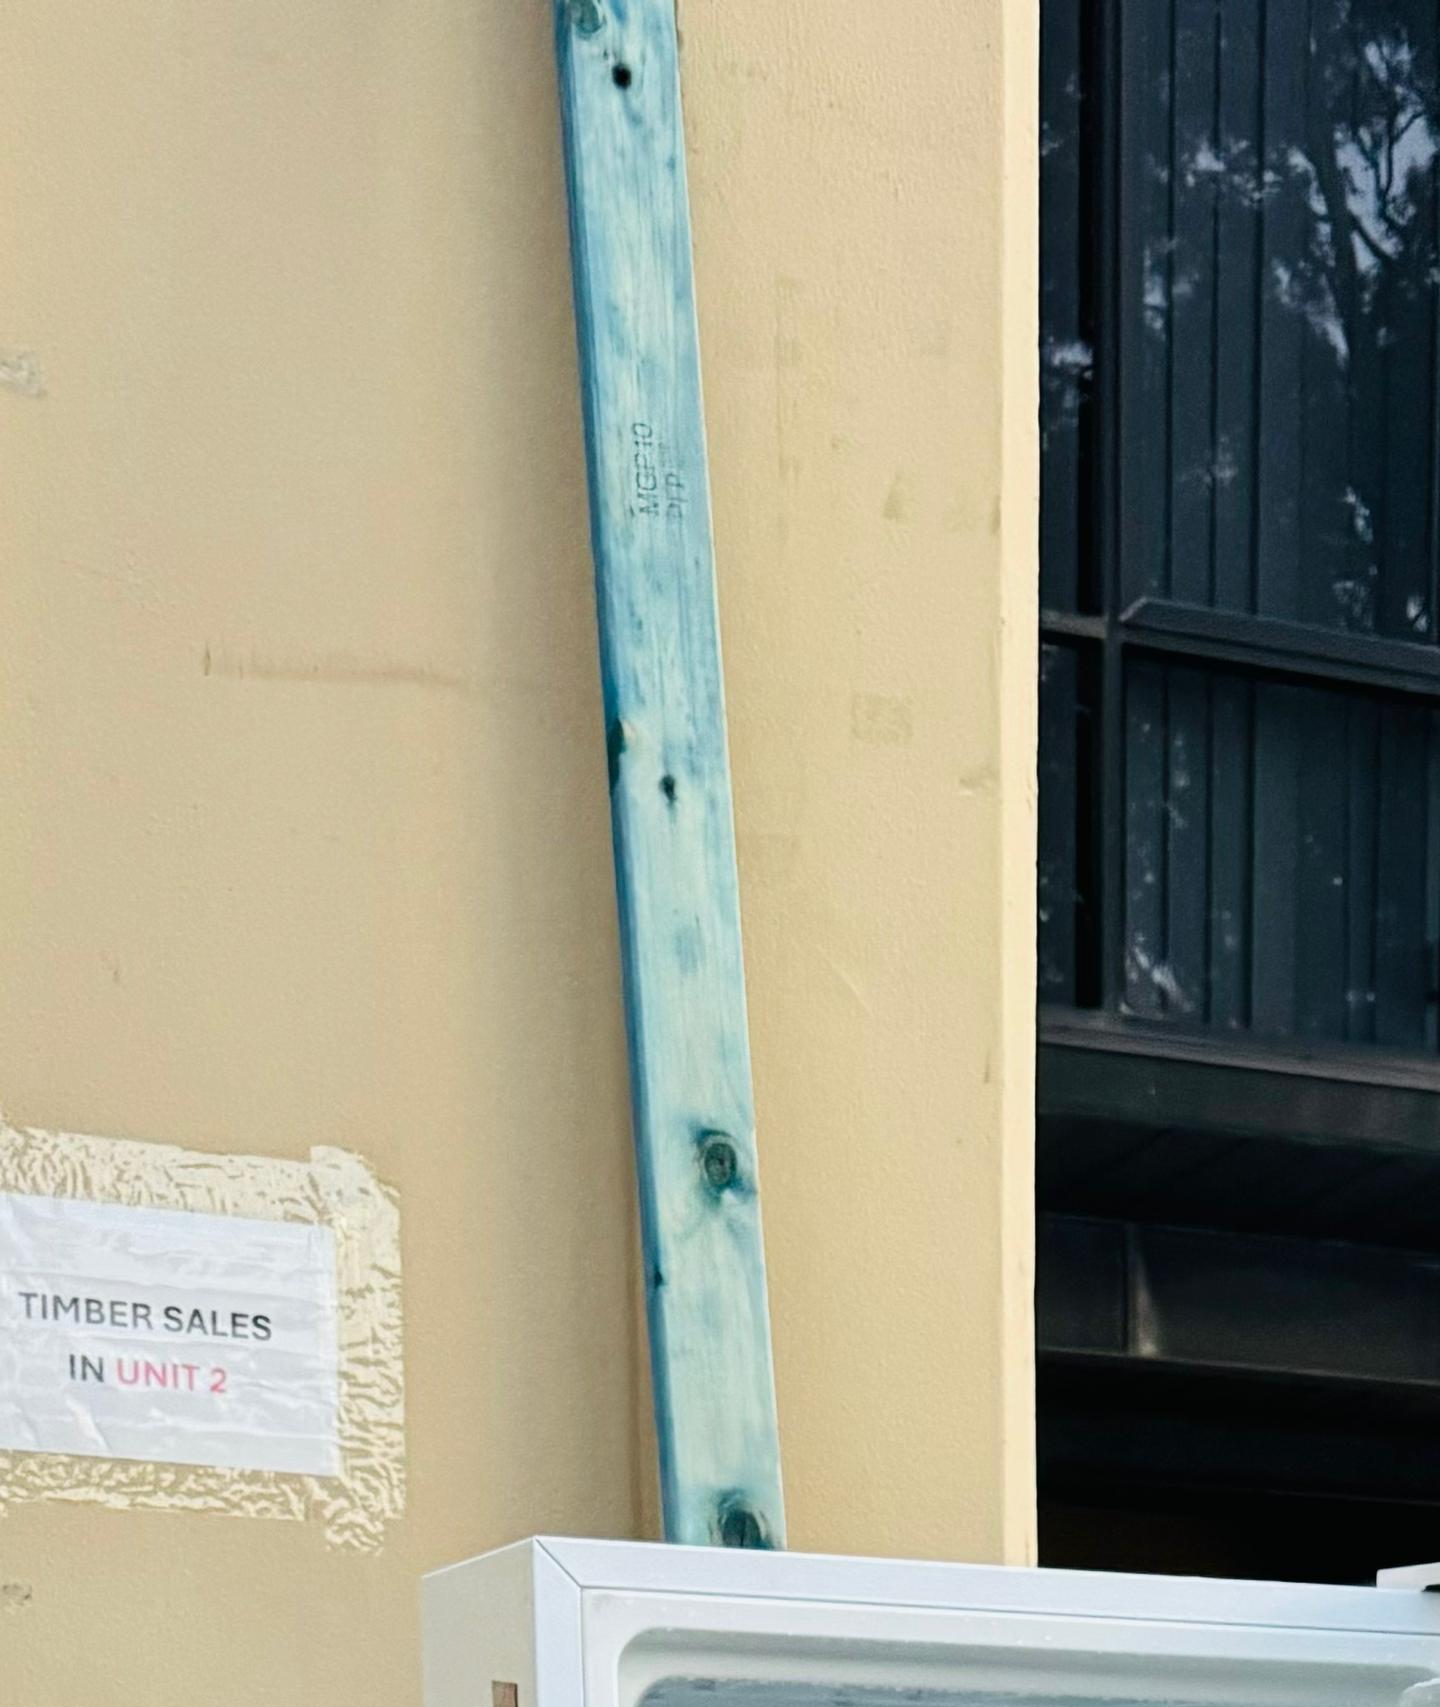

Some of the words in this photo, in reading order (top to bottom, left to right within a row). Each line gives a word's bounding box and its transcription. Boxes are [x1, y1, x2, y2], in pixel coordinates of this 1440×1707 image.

[631, 422, 659, 518] MGP10
[18, 1292, 154, 1330] TIMBER
[163, 1306, 273, 1341] SALES
[69, 1354, 105, 1383] IN
[116, 1358, 200, 1391] UNIT
[210, 1368, 227, 1393] 2
